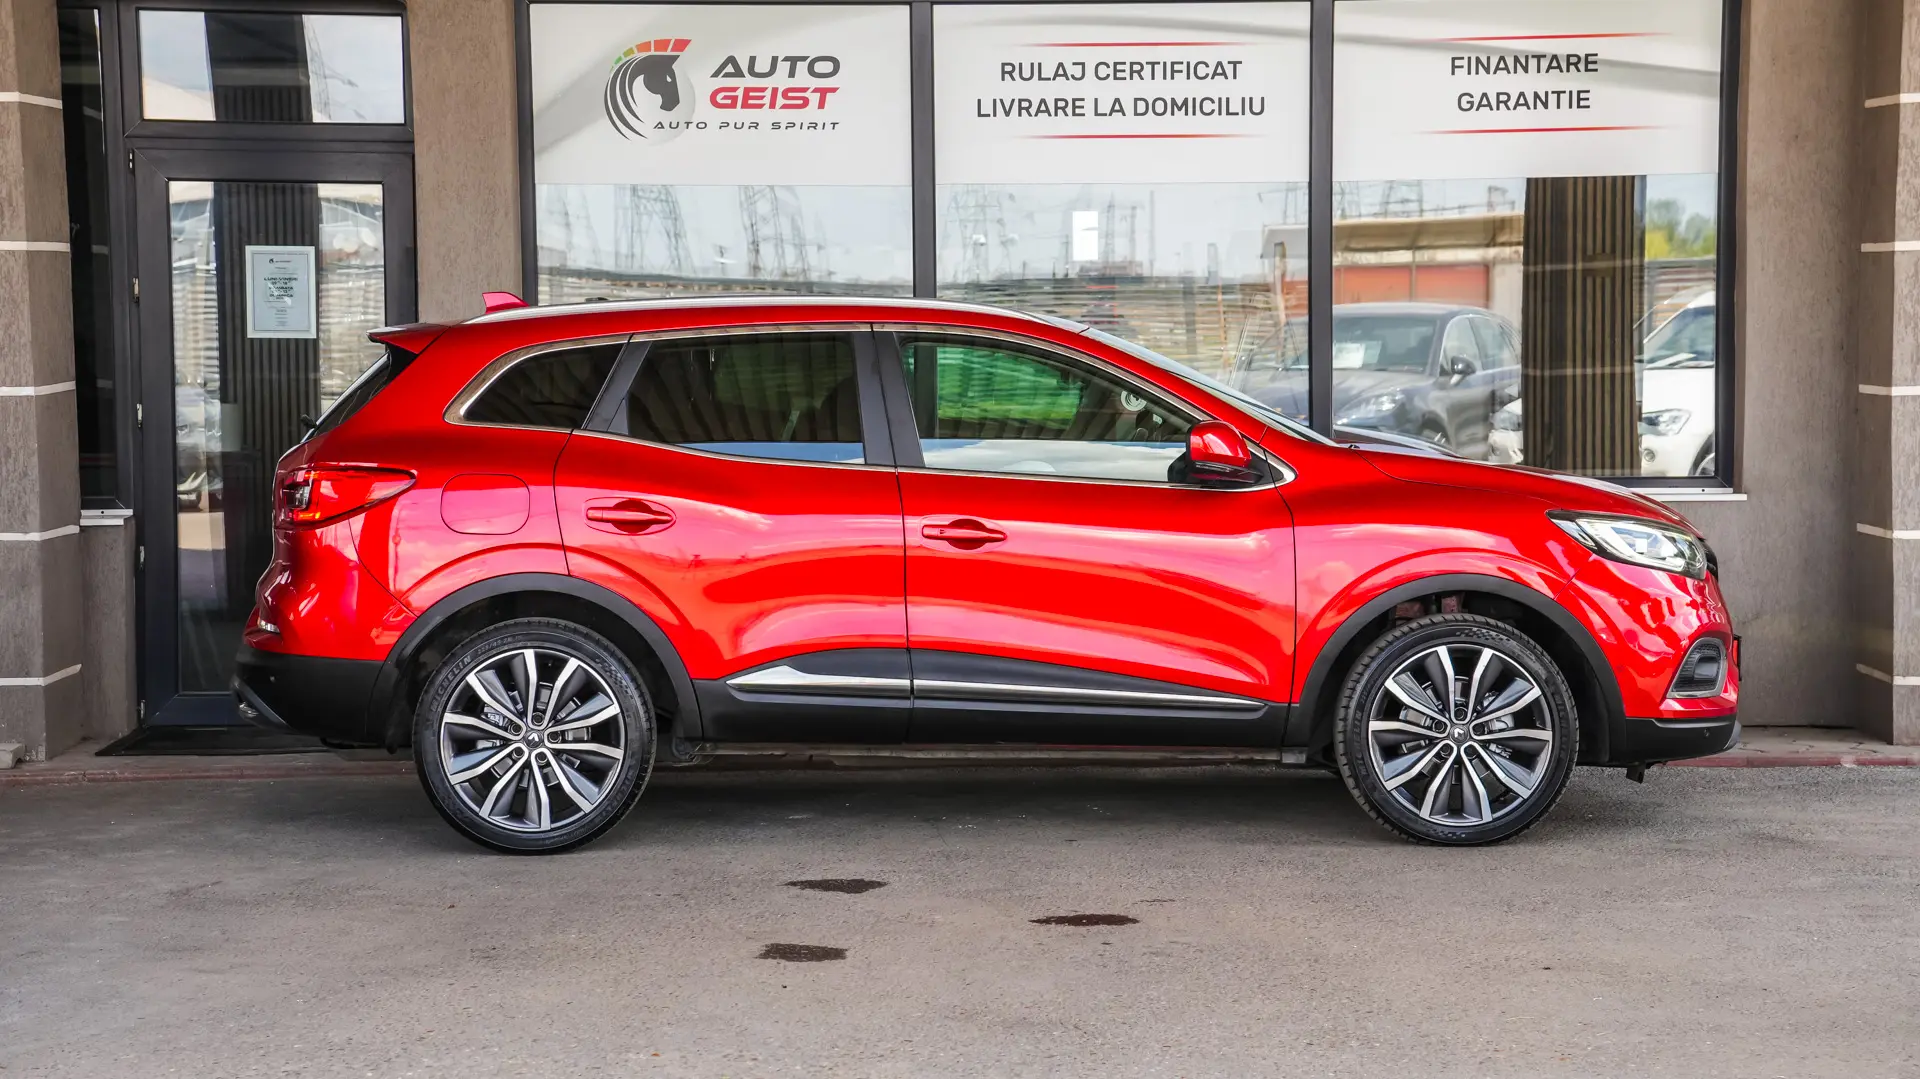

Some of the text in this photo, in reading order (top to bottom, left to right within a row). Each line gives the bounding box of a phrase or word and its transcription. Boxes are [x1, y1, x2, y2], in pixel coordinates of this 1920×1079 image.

[709, 55, 841, 79] AUTO
[1000, 60, 1243, 82] RULAJ CERTIFICAT
[1451, 52, 1599, 76] FINANTARE
[709, 86, 841, 110] GEIST
[976, 96, 1265, 118] LIVRARE LA DOMICILIU
[1457, 89, 1591, 112] GARANTIE
[652, 121, 840, 131] AUTO PUR SPIRIT
[430, 655, 472, 712] MICHELIN
